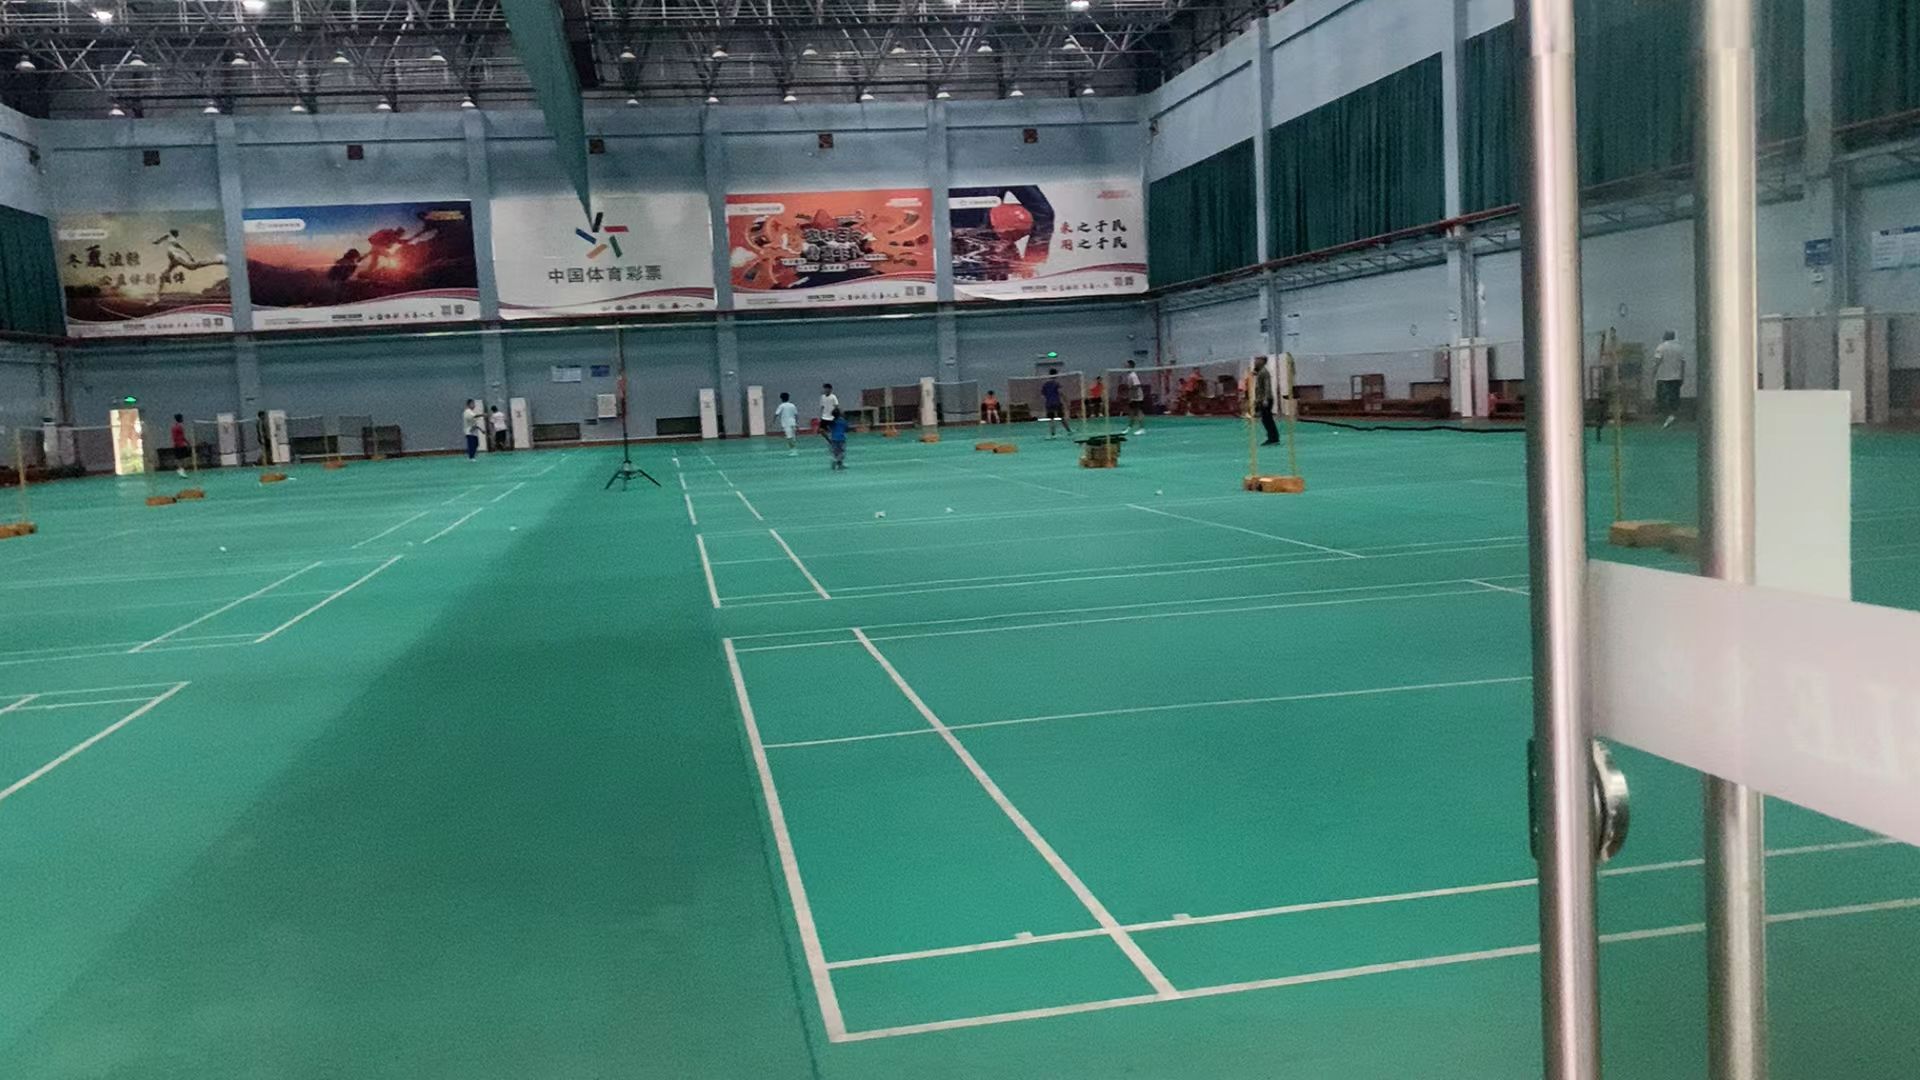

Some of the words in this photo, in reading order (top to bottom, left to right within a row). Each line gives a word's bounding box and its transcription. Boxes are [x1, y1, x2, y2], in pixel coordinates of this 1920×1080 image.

[1060, 236, 1128, 251] 用之于民
[548, 265, 662, 284] 中国体育彩票
